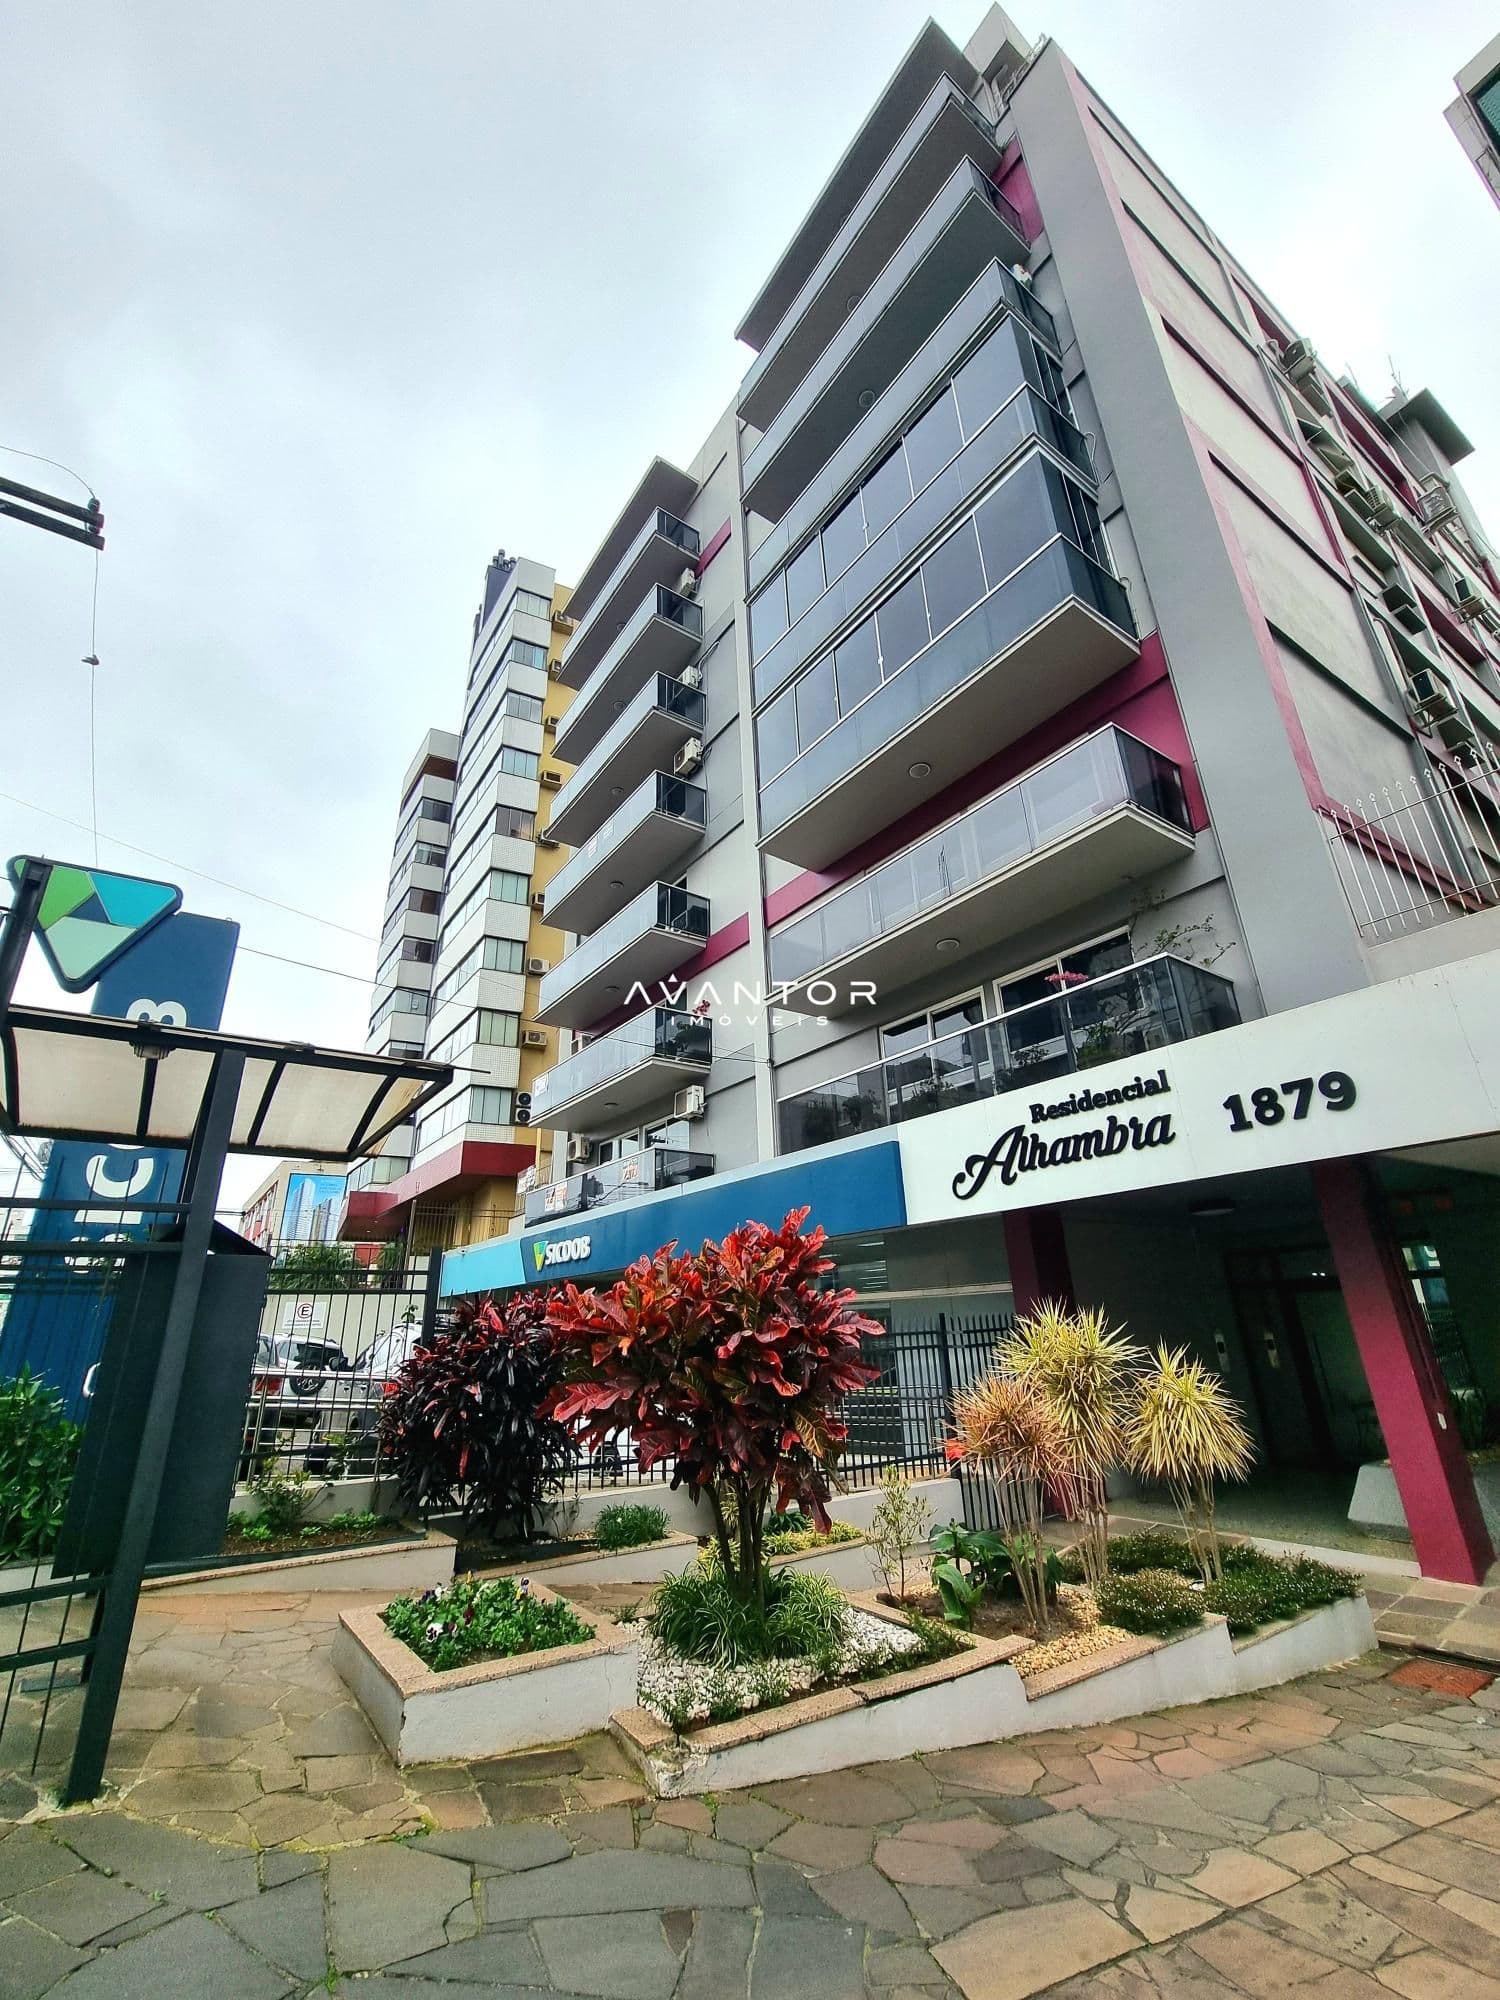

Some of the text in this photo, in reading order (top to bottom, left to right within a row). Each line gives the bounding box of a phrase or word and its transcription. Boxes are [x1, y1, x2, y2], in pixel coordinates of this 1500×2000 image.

[1029, 1069, 1171, 1124] Residencial
[1222, 1070, 1358, 1132] 1879
[952, 1113, 1176, 1200] Alhambra
[545, 1235, 591, 1266] SICOOB
[300, 1306, 310, 1316] E
